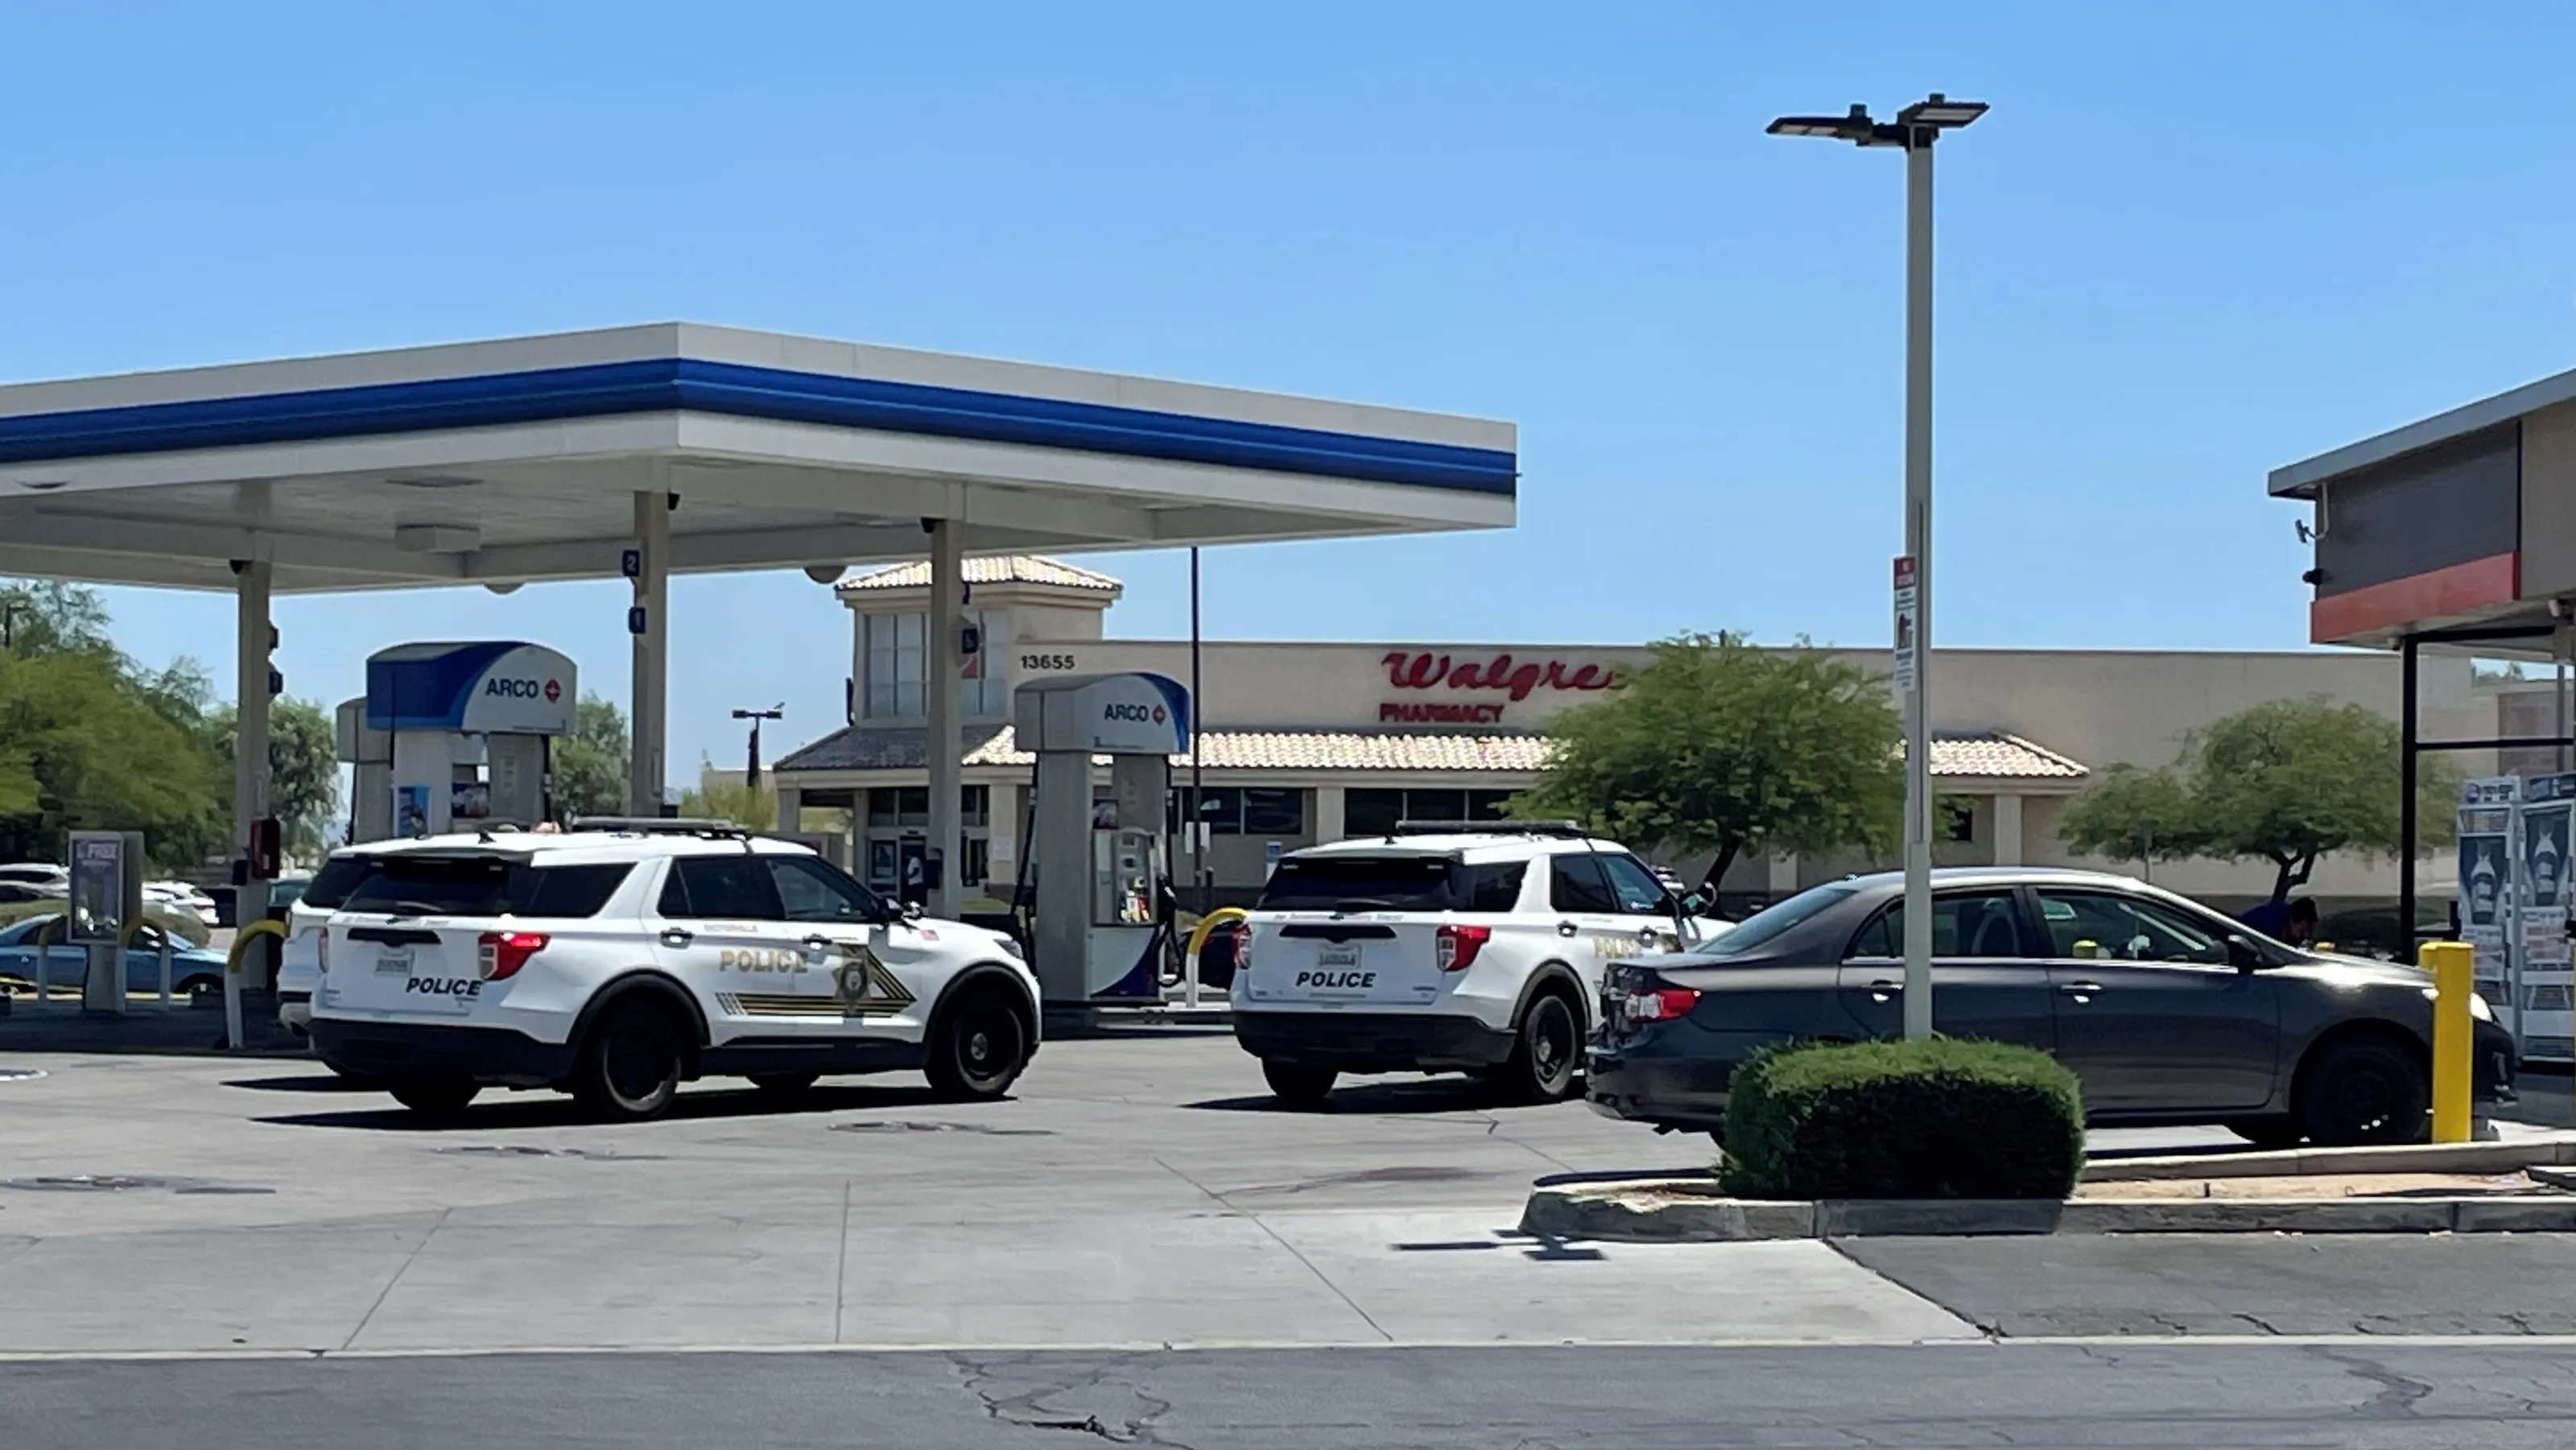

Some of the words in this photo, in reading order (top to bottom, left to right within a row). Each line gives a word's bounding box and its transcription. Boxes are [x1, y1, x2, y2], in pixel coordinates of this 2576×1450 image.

[627, 554, 637, 572] 2
[1021, 655, 1075, 670] 13655
[1381, 652, 1615, 702] Walgre
[485, 678, 539, 699] ARCO
[1104, 704, 1149, 722] ARCO
[1380, 703, 1504, 723] PHARMACY
[719, 949, 809, 973] POLICE
[406, 977, 484, 996] POLICE
[1296, 972, 1377, 988] POLICE
